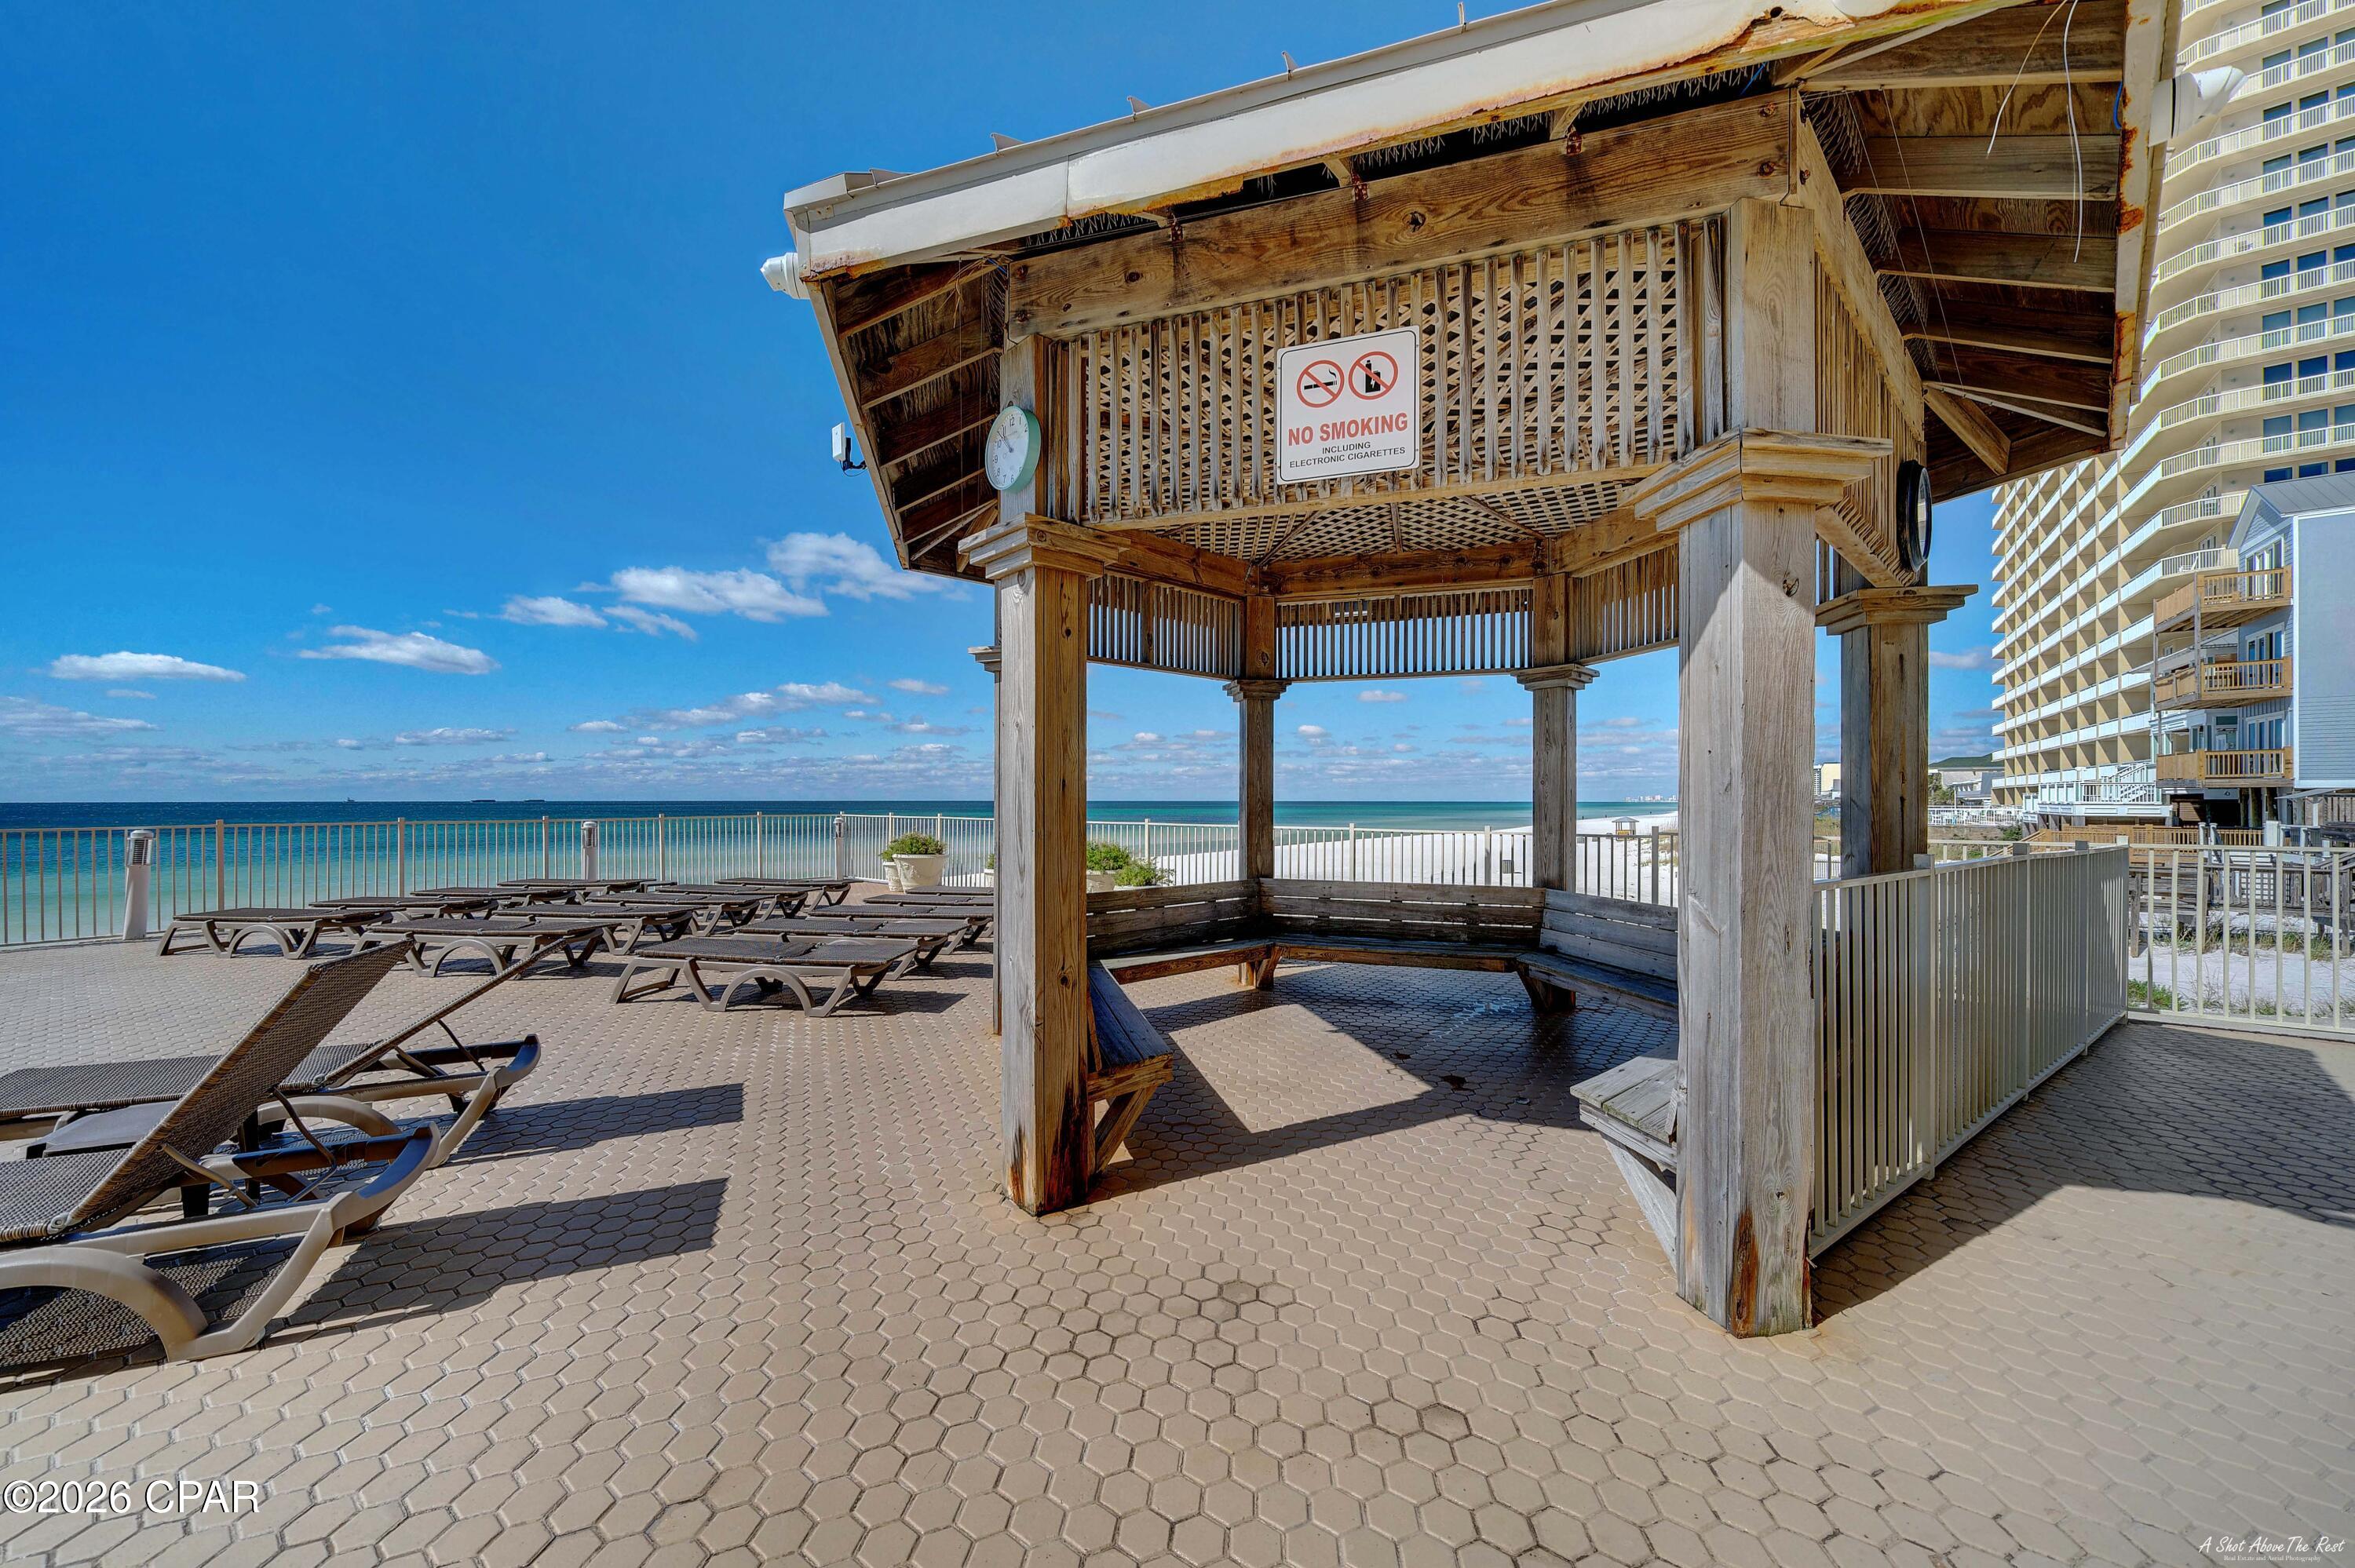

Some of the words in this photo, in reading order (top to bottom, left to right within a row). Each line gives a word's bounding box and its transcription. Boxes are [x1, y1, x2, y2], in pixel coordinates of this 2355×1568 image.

[1010, 416, 1015, 427] 12
[1288, 425, 1313, 446] NO
[1320, 412, 1408, 442] SMOKING
[1322, 441, 1371, 454] INCLUDING
[1290, 454, 1345, 469] ELECTRONIC
[1347, 447, 1406, 461] CIGARETTES
